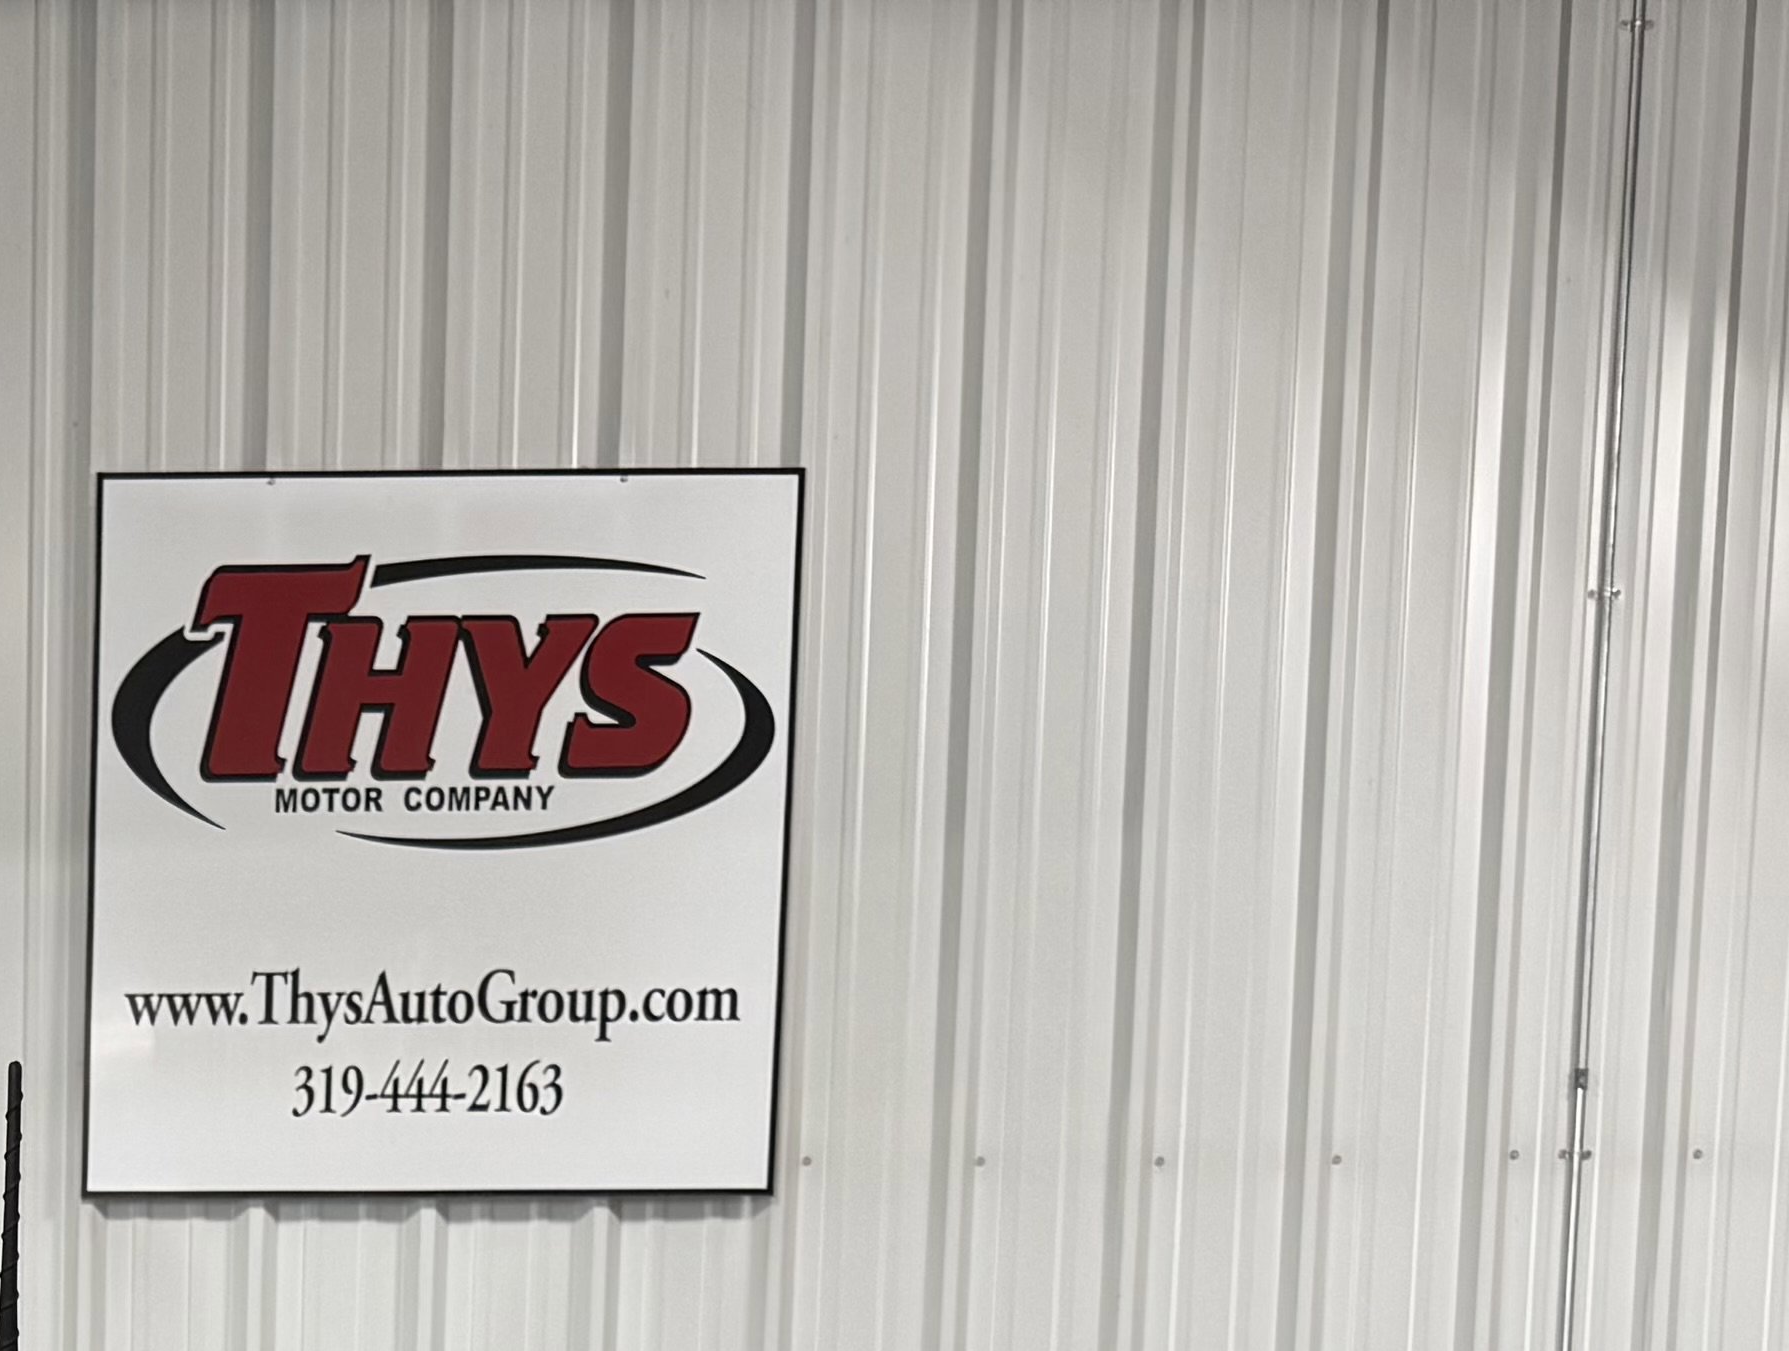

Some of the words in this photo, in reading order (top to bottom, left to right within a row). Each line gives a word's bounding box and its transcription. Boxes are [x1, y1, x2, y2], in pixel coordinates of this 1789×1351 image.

[190, 554, 700, 782] THYS
[275, 787, 384, 814] MOTOR
[403, 785, 556, 813] COMPANY
[124, 967, 742, 1043] www.ThysAutoGroup.com
[291, 1058, 564, 1118] 319-444-2163
